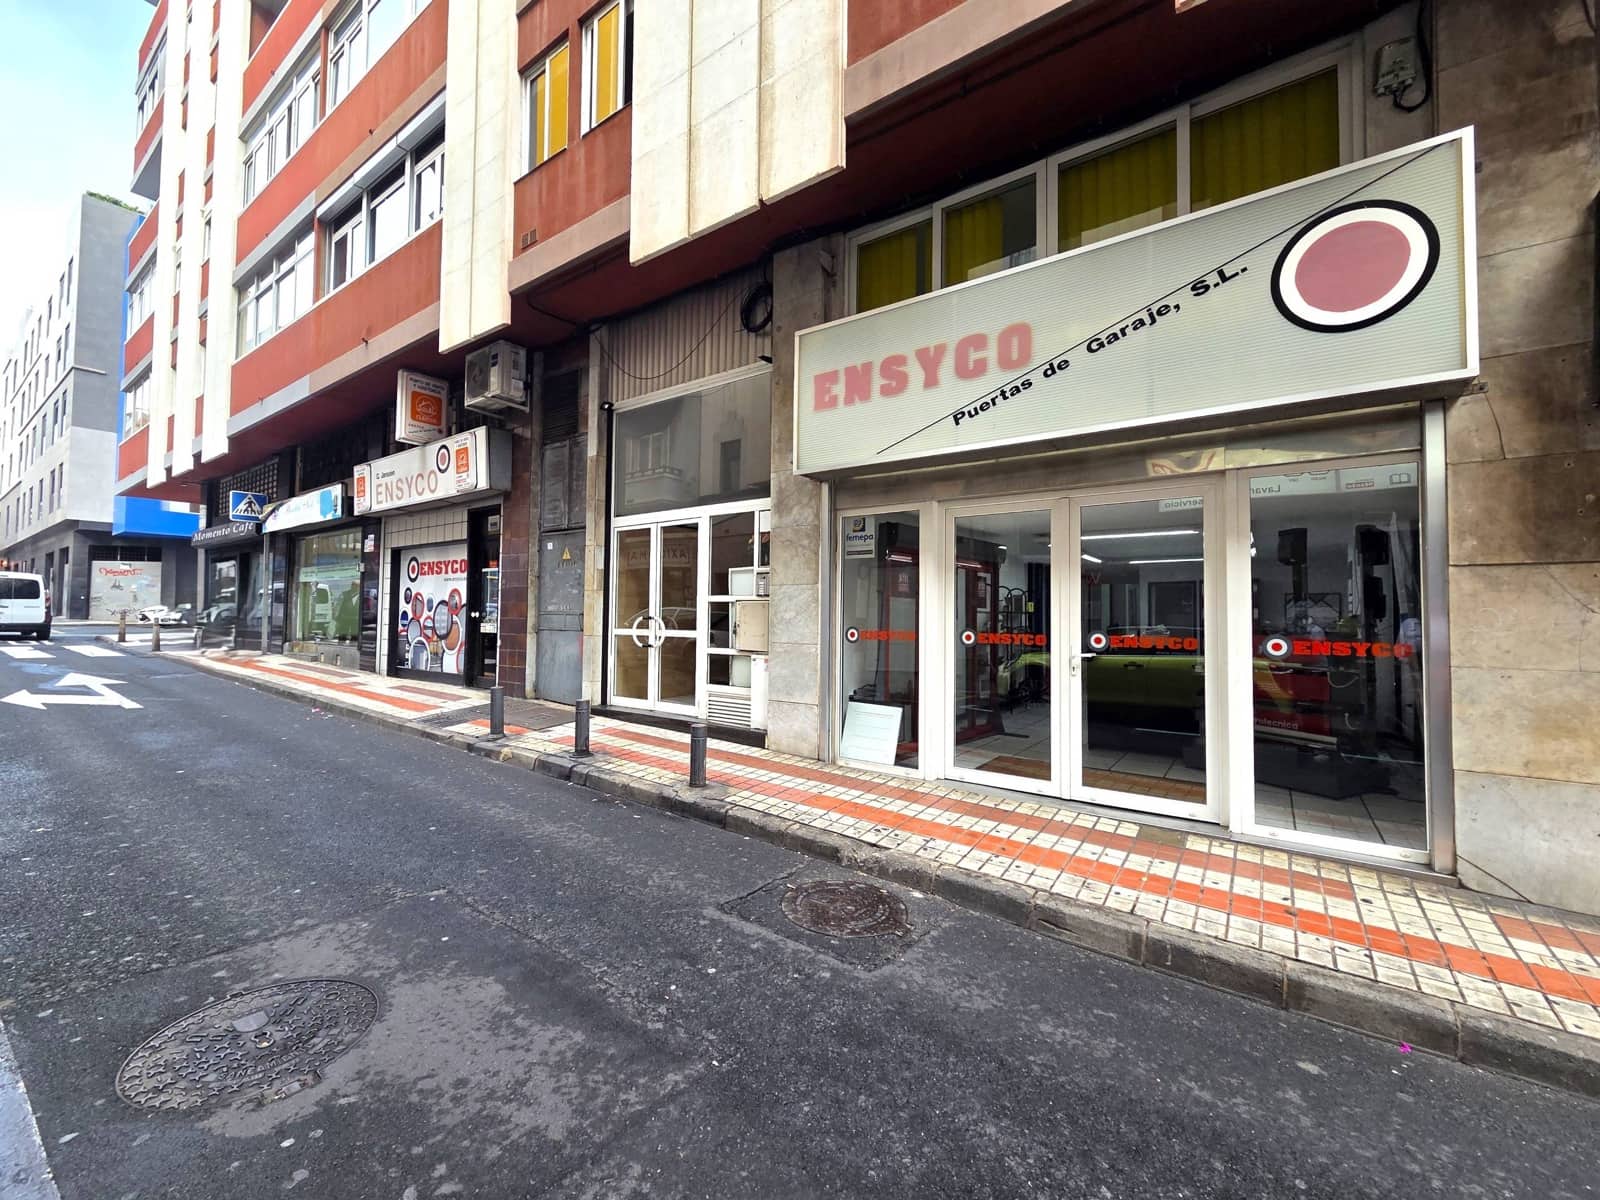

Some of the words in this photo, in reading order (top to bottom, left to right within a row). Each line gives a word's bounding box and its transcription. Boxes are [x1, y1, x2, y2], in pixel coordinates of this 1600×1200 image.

[952, 377, 1033, 426] Puertas
[1042, 358, 1070, 378] de
[1086, 302, 1181, 354] Garaje,
[1190, 266, 1248, 297] S.L.
[813, 321, 1033, 412] ENSYCO
[376, 469, 438, 504] ENSYCO
[192, 527, 231, 542] Momento
[846, 533, 874, 543] femepa
[420, 559, 468, 576] ENSYCO
[977, 632, 1047, 646] ENSYCO
[1109, 634, 1199, 650] ENSYCO
[1292, 640, 1413, 659] ENSYCO
